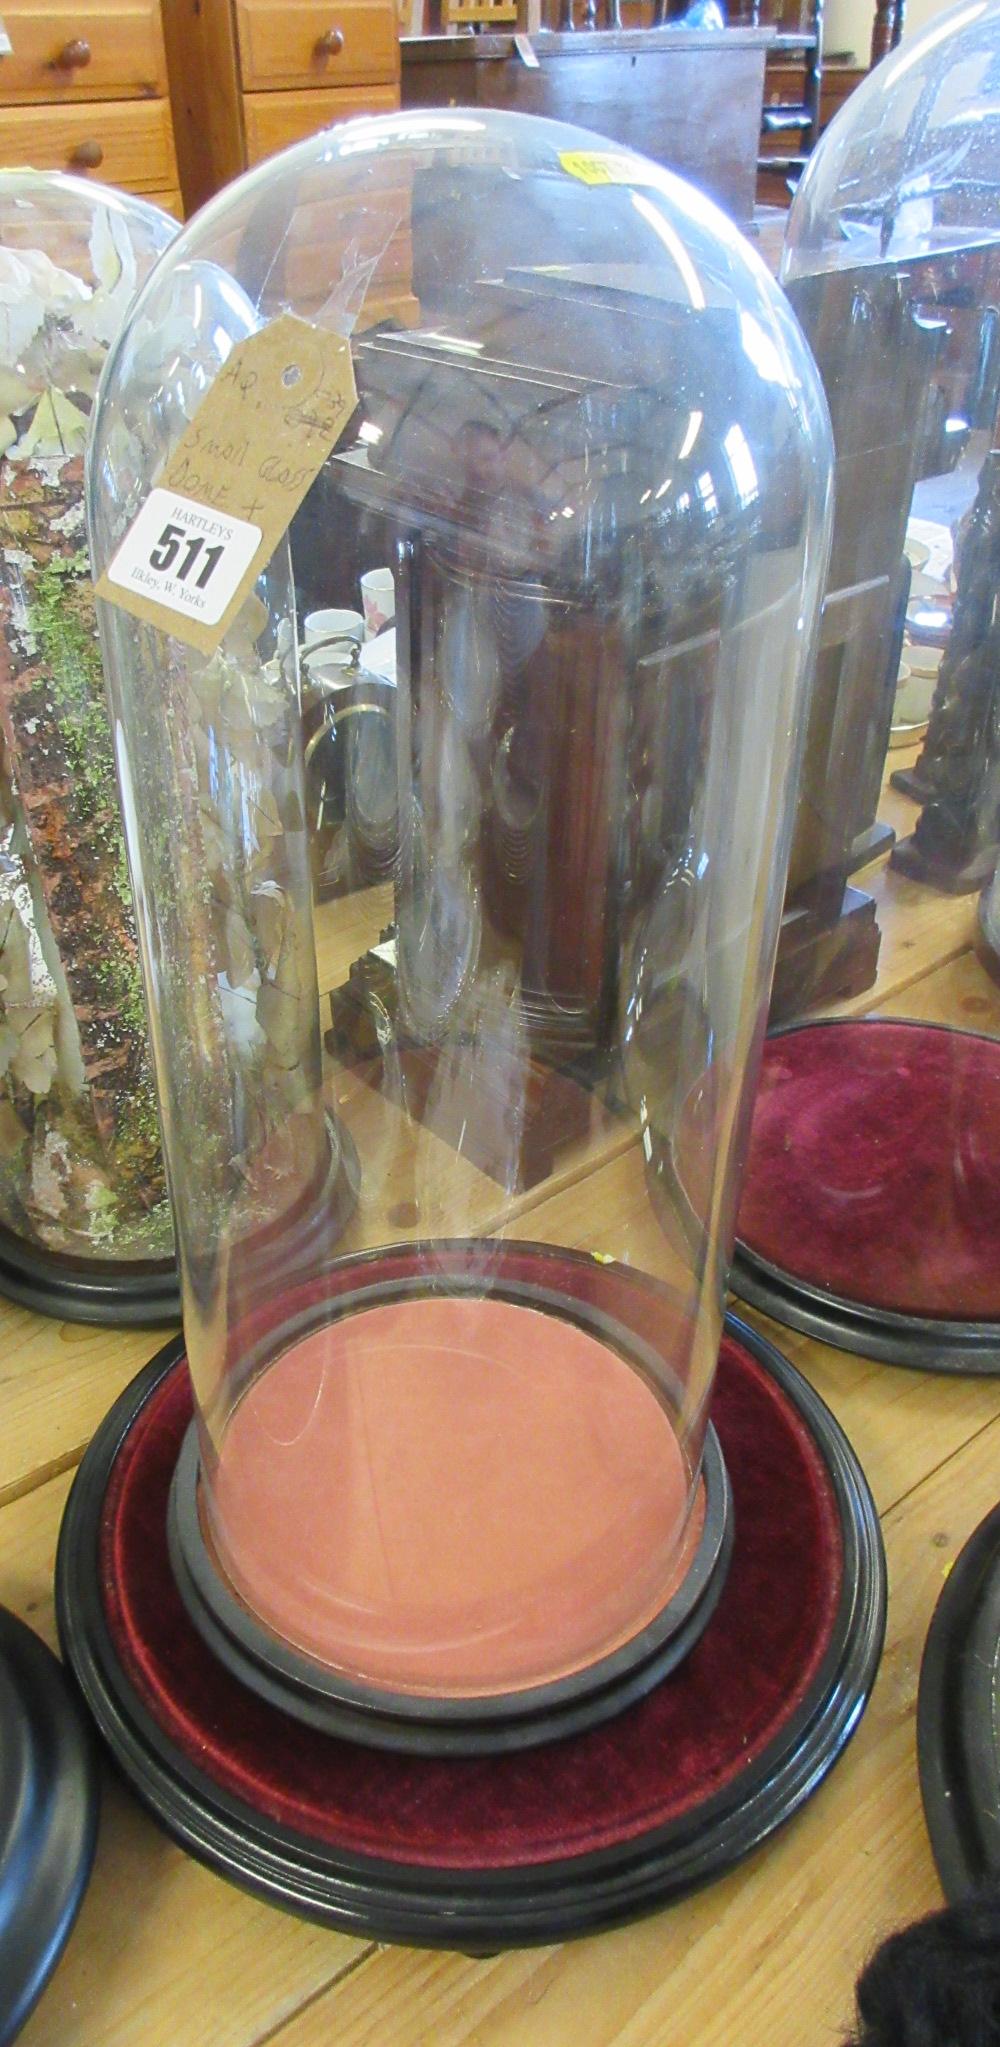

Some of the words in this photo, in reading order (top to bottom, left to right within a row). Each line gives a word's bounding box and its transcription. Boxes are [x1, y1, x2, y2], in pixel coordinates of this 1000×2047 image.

[170, 506, 234, 541] HARTLEYS
[149, 523, 225, 589] 511
[179, 586, 207, 609] Yorks
